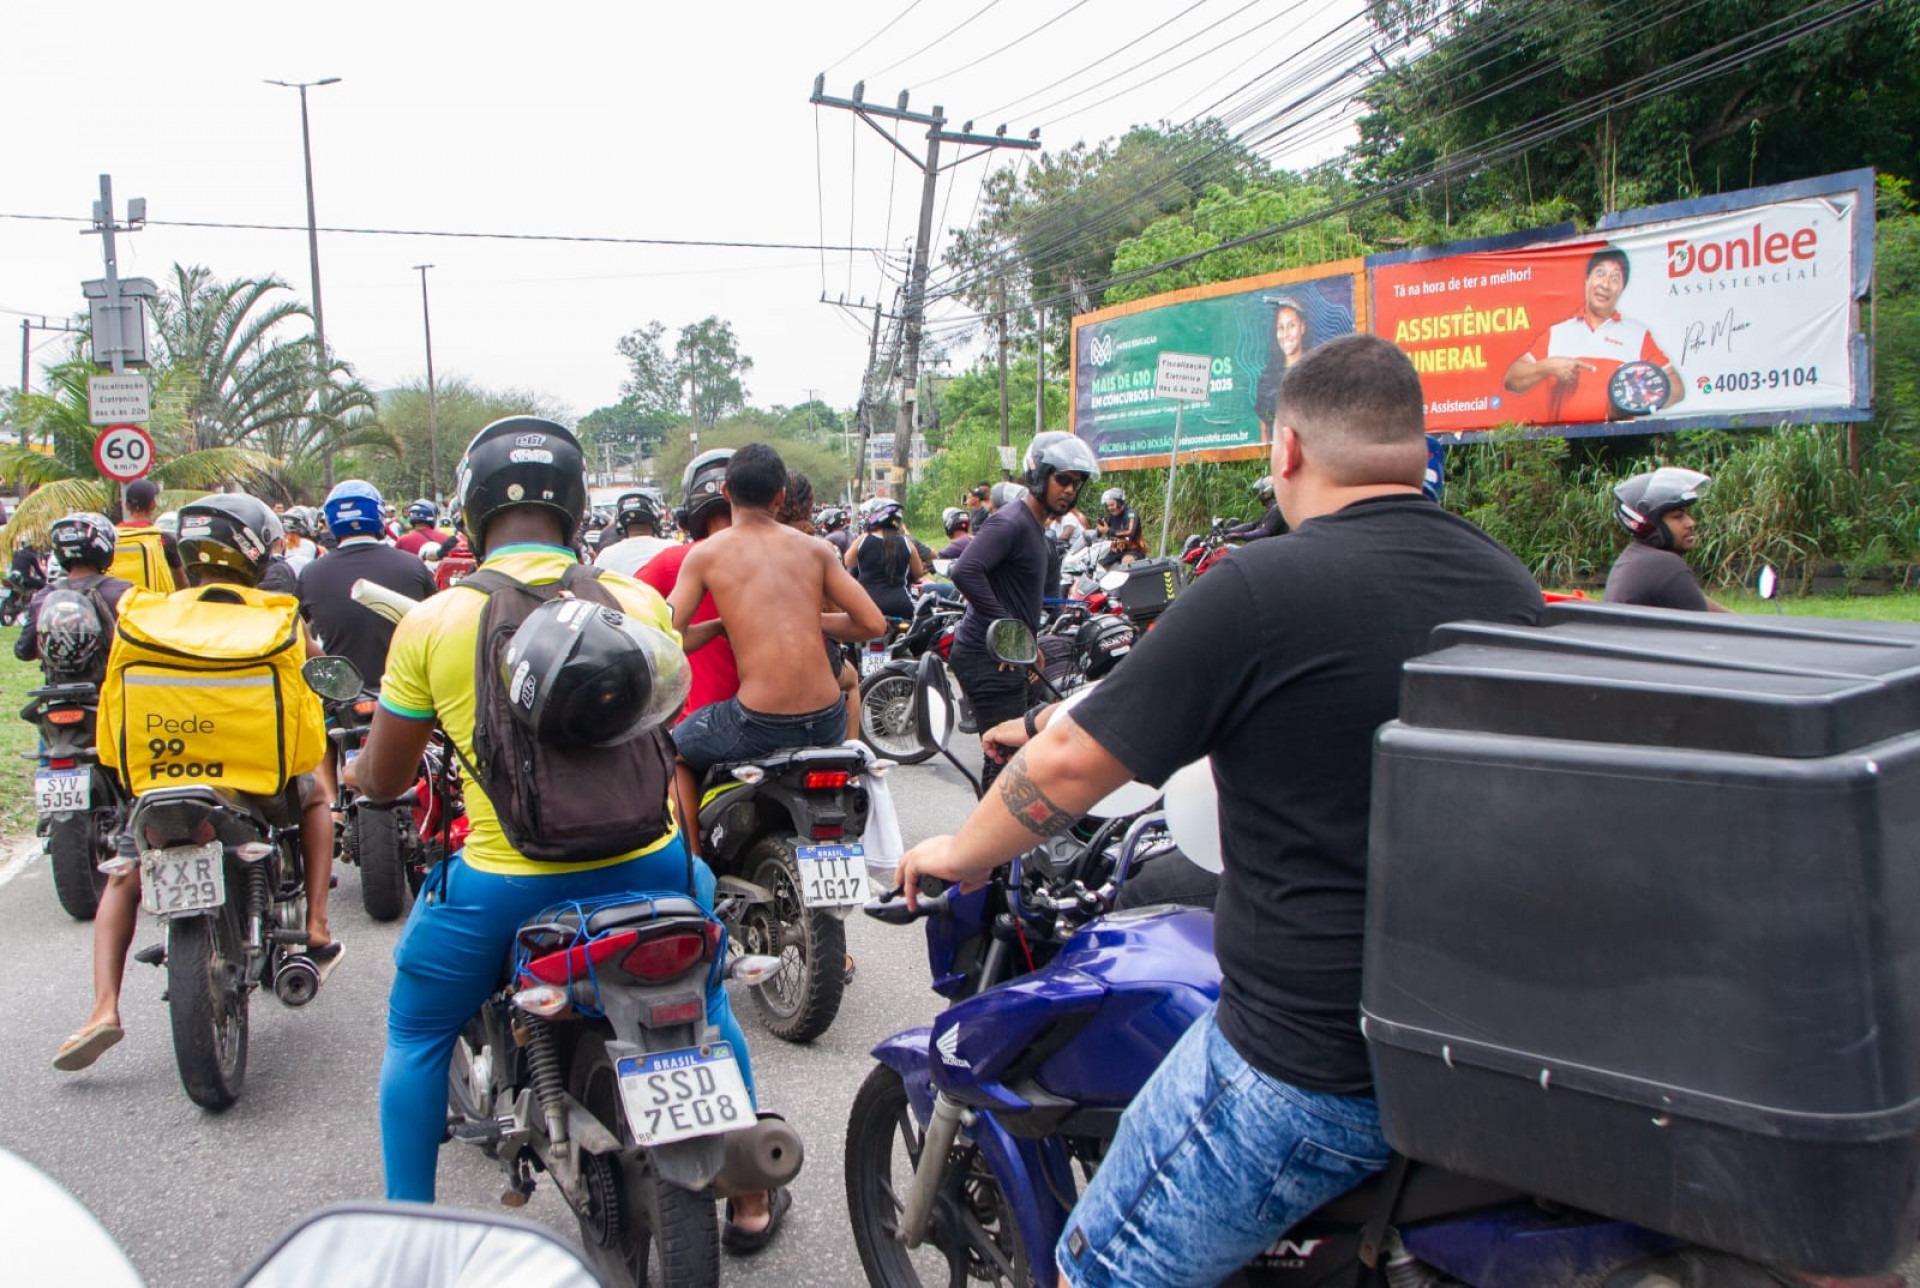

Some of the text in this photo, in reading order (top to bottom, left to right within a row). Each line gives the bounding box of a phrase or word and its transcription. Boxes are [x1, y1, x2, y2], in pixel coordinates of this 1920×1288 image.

[1667, 222, 1817, 279] Donlee
[1393, 266, 1532, 298] Tá na hora de ter a melhor!
[1395, 304, 1531, 344] ASSISTÊNCIA
[1406, 345, 1488, 374] UNERAL
[1091, 377, 1116, 395] MAIS
[1117, 373, 1130, 389] DE
[1133, 369, 1151, 387] 410
[1103, 388, 1149, 407] CONCURSOS
[1430, 397, 1488, 414] Assistencial
[106, 438, 145, 461] 60
[114, 463, 139, 471] km/h
[146, 714, 215, 734] Pede
[149, 738, 186, 759] 99
[47, 777, 78, 792] SYV
[42, 791, 83, 809] 5J54
[817, 849, 845, 858] BRASIL
[151, 858, 211, 887] KXR
[813, 857, 851, 879] TTT
[155, 882, 216, 911] 1239
[811, 878, 860, 900] 1G17
[653, 1055, 698, 1071] BRASIL
[647, 1066, 716, 1105] SSD
[643, 1095, 738, 1135] 7E08
